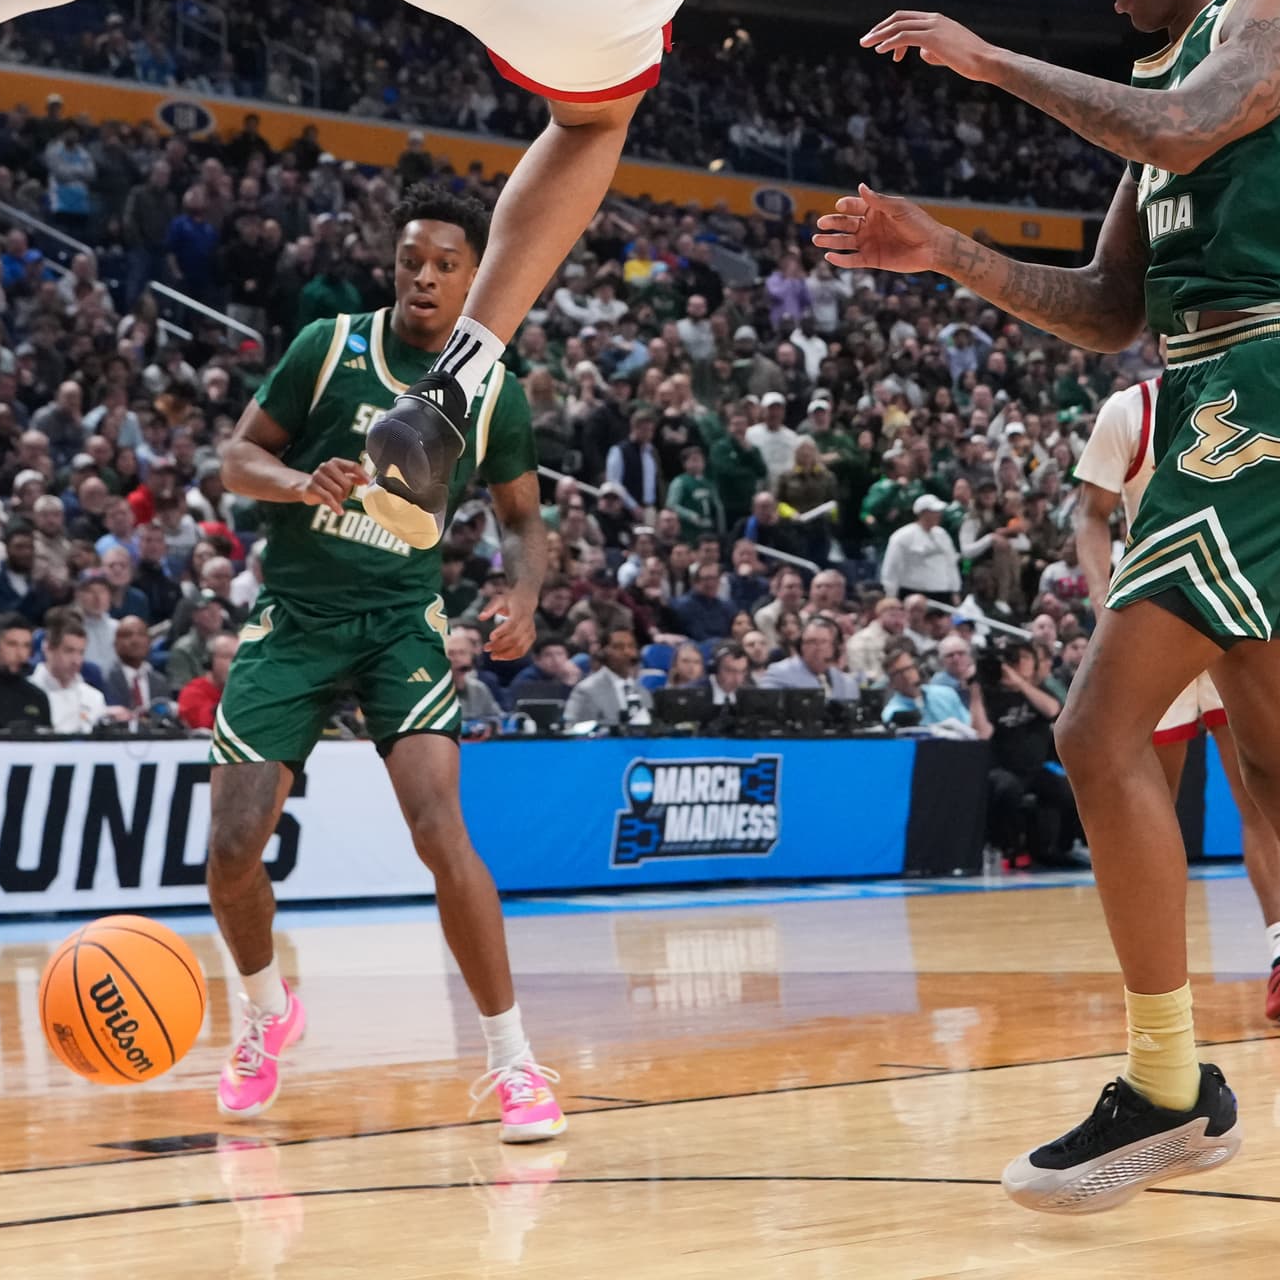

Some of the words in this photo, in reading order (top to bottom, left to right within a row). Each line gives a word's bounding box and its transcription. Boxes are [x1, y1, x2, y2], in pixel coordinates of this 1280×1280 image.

[311, 505, 411, 557] FLORIDA
[652, 765, 741, 804] MARCH
[663, 803, 777, 842] MADNESS
[90, 973, 154, 1075] Wilson
